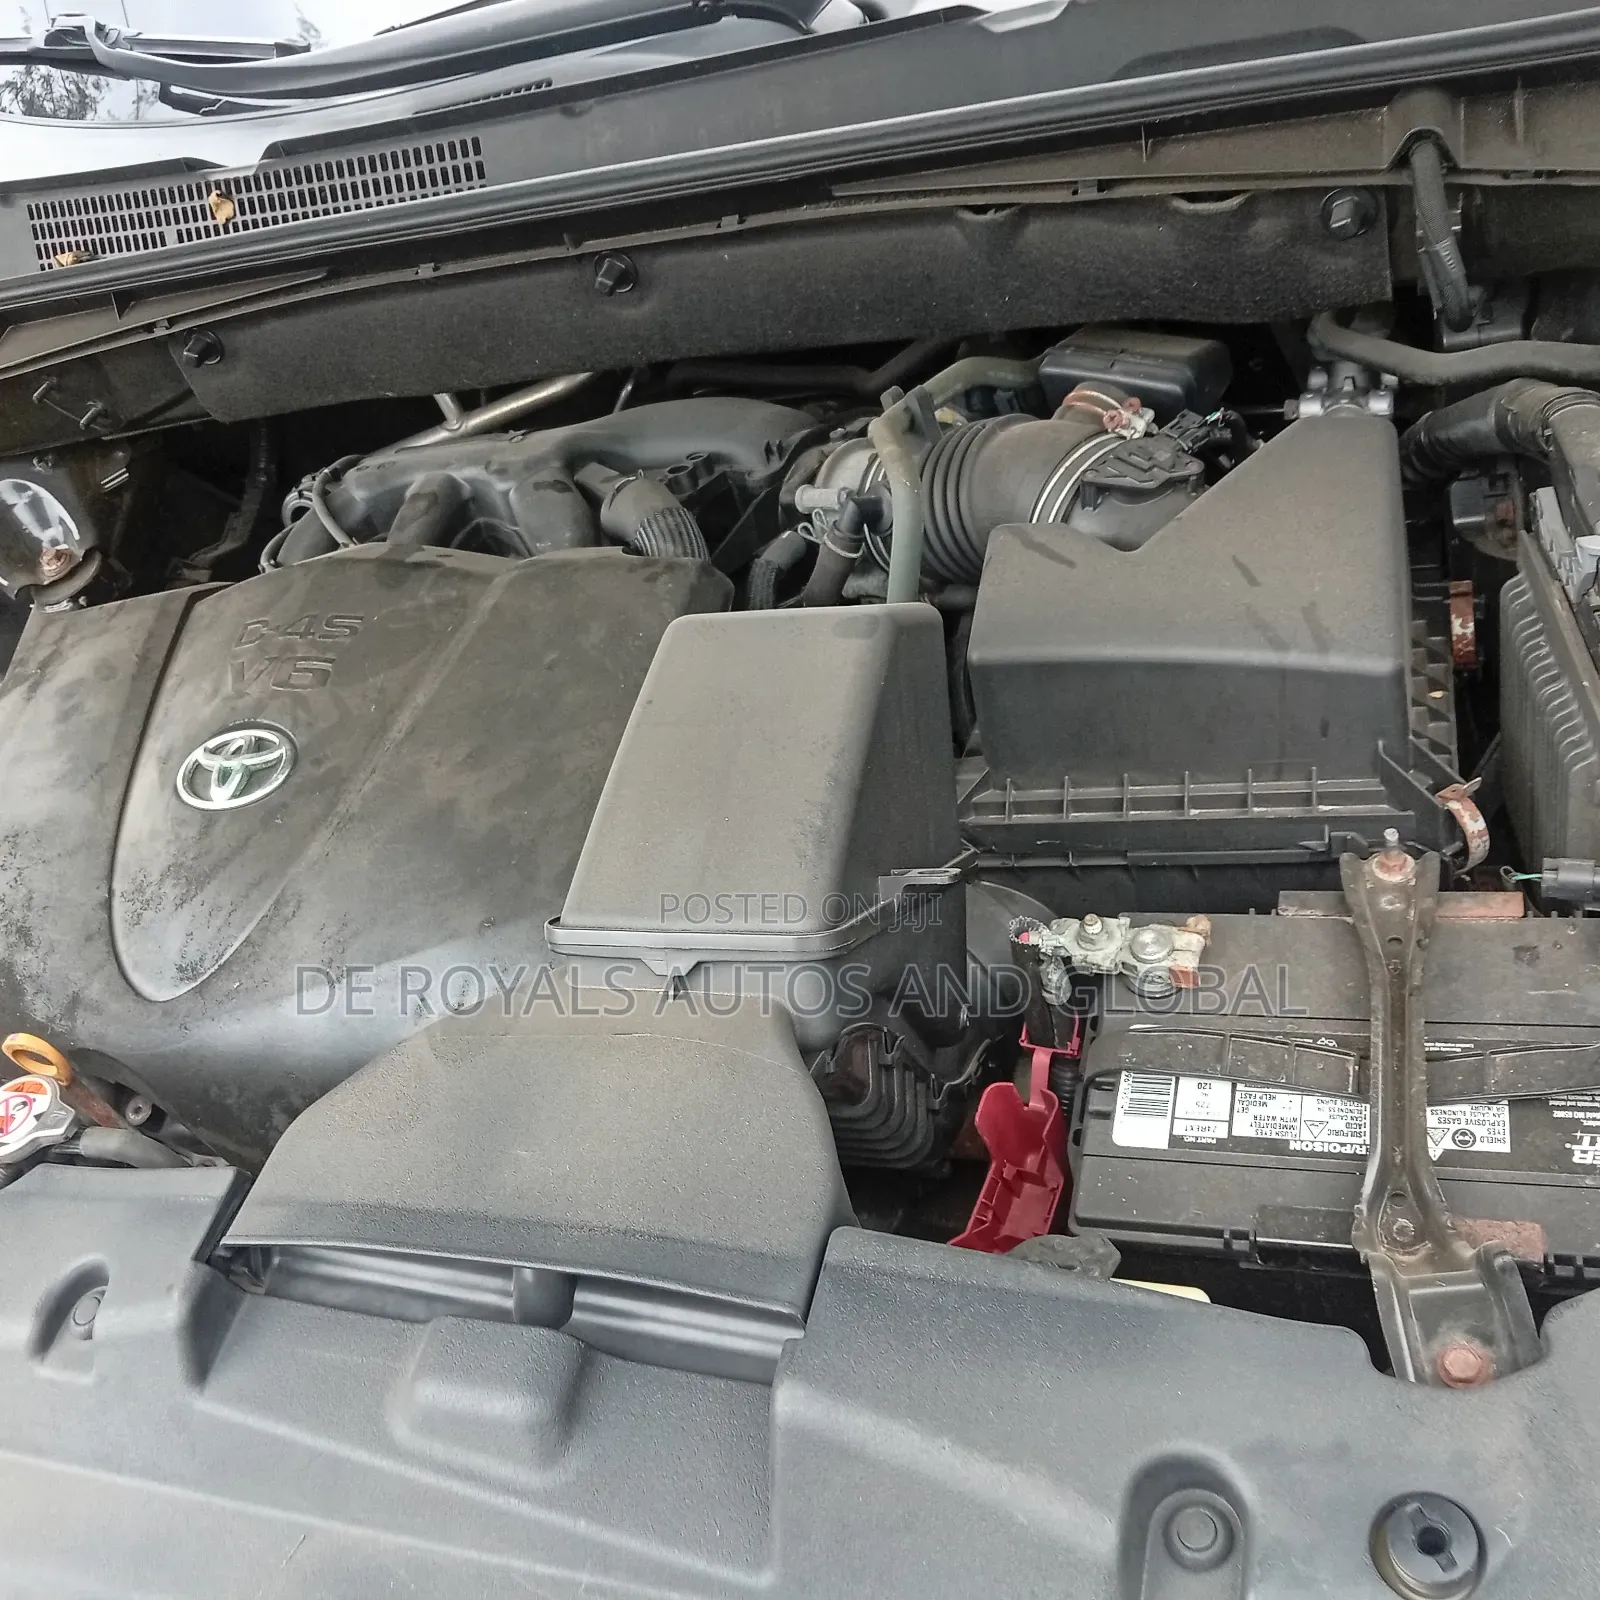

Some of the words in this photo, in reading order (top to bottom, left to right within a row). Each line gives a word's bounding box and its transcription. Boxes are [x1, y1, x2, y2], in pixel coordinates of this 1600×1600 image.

[228, 655, 337, 697] V6
[1197, 1082, 1212, 1090] 120
[1240, 1092, 1257, 1100] FAST
[1259, 1093, 1277, 1101] HELP
[1237, 1099, 1268, 1108] MEDICAL
[1237, 1106, 1250, 1114] GET
[1430, 1109, 1467, 1117] BLINDNESS
[1253, 1114, 1277, 1122] WATER
[1437, 1116, 1462, 1125] GASES
[1250, 1121, 1298, 1131] IMMEDIATELY
[1345, 1122, 1363, 1130] ACID
[1464, 1118, 1506, 1127] EXPLOSIVE
[1254, 1128, 1273, 1137] EYES
[1275, 1130, 1298, 1139] FLUSH
[1327, 1129, 1363, 1139] SULFURIC
[1487, 1127, 1506, 1135] EYES
[1196, 1137, 1217, 1145] PART
[1480, 1135, 1507, 1144] SHIELD
